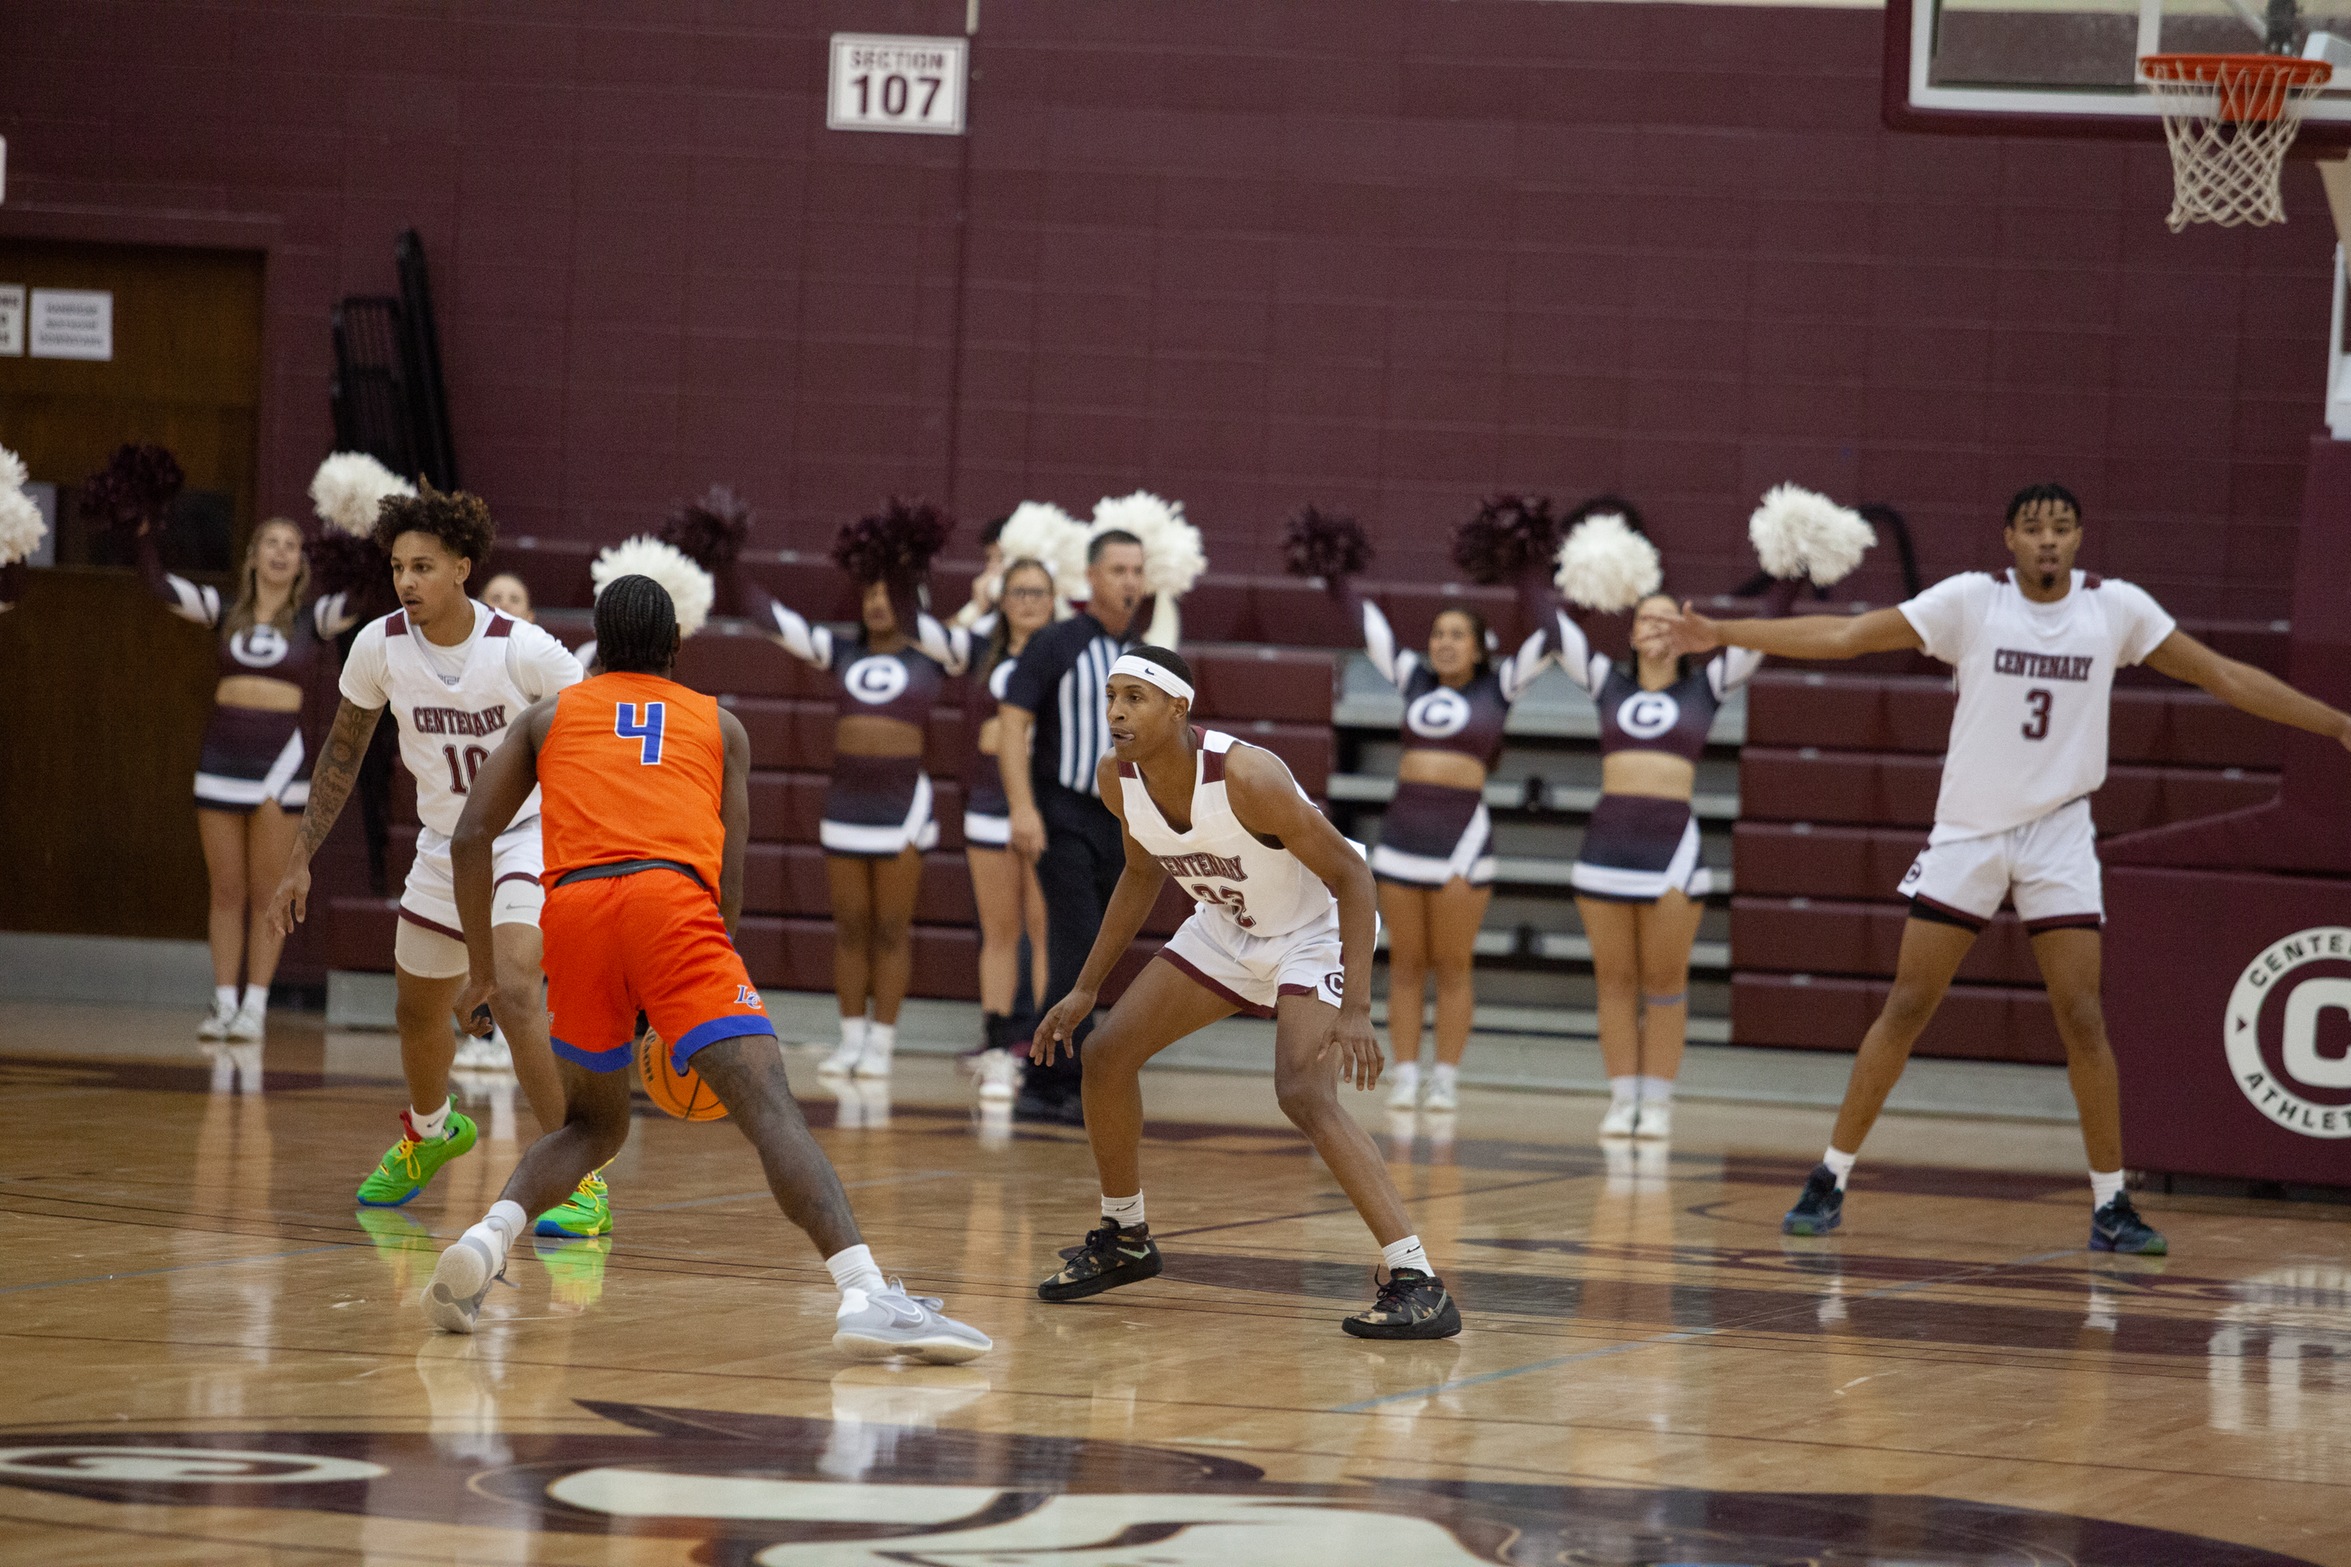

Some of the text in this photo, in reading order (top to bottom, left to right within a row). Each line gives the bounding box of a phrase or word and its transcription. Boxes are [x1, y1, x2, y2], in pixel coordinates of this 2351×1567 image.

[851, 74, 942, 118] 107
[1995, 649, 2093, 682] CENTENARY
[412, 704, 507, 737] CENTENARY
[614, 702, 665, 766] 4
[2022, 688, 2053, 741] 3
[2248, 934, 2351, 988] CENTE
